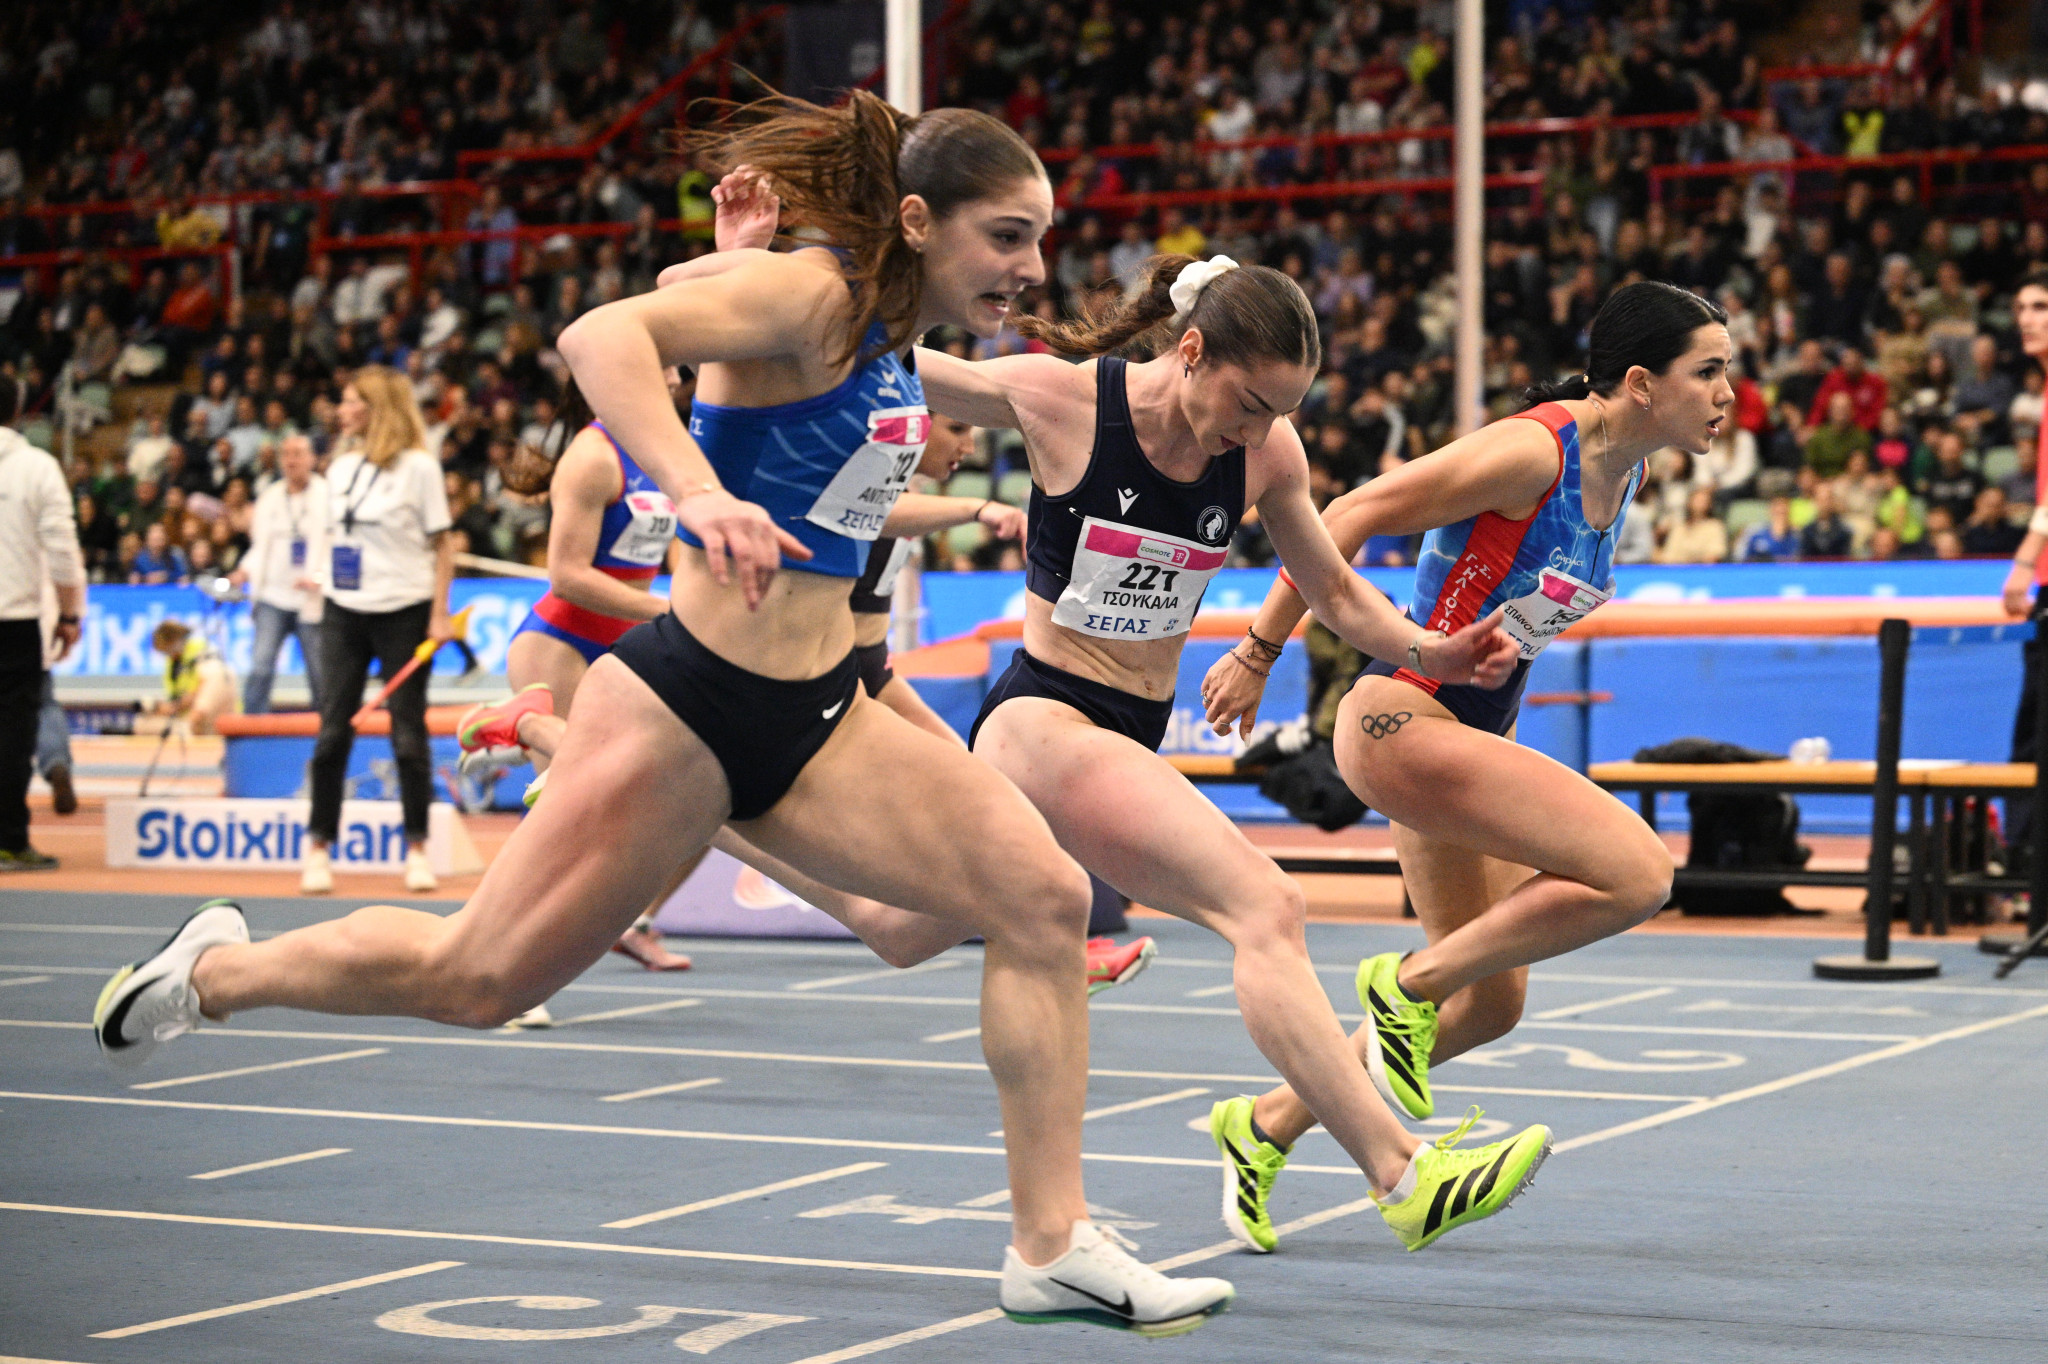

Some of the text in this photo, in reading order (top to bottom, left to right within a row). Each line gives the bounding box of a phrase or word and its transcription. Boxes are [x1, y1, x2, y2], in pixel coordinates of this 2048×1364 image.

[1140, 546, 1171, 558] COSMOTE
[1103, 591, 1179, 609] ΤΣΟΥΚΑΛΑ
[1083, 614, 1152, 634] ΣΕΓΑΣ
[374, 1294, 822, 1355] 5
